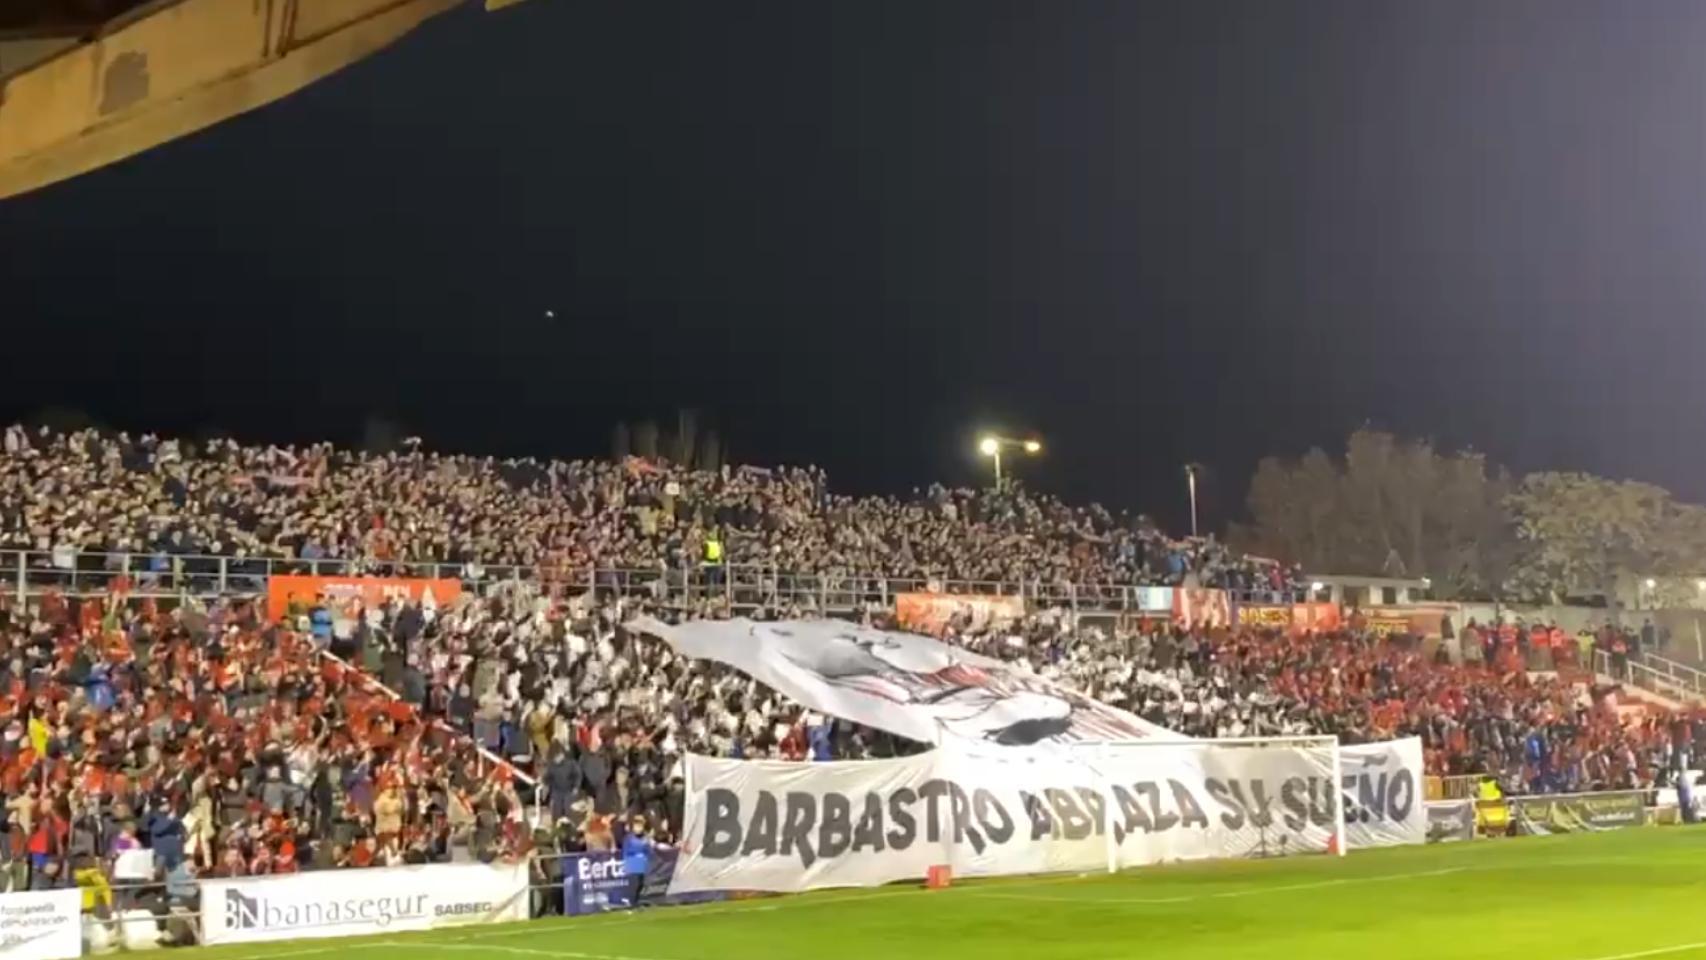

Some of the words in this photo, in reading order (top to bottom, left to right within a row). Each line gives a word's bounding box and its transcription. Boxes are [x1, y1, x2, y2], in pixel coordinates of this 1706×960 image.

[700, 779, 1015, 869] BARBASTRO
[1018, 778, 1209, 846] ABRAZA
[1205, 777, 1273, 831] SU
[1281, 754, 1414, 833] SUEÑO
[264, 894, 429, 926] banasegur
